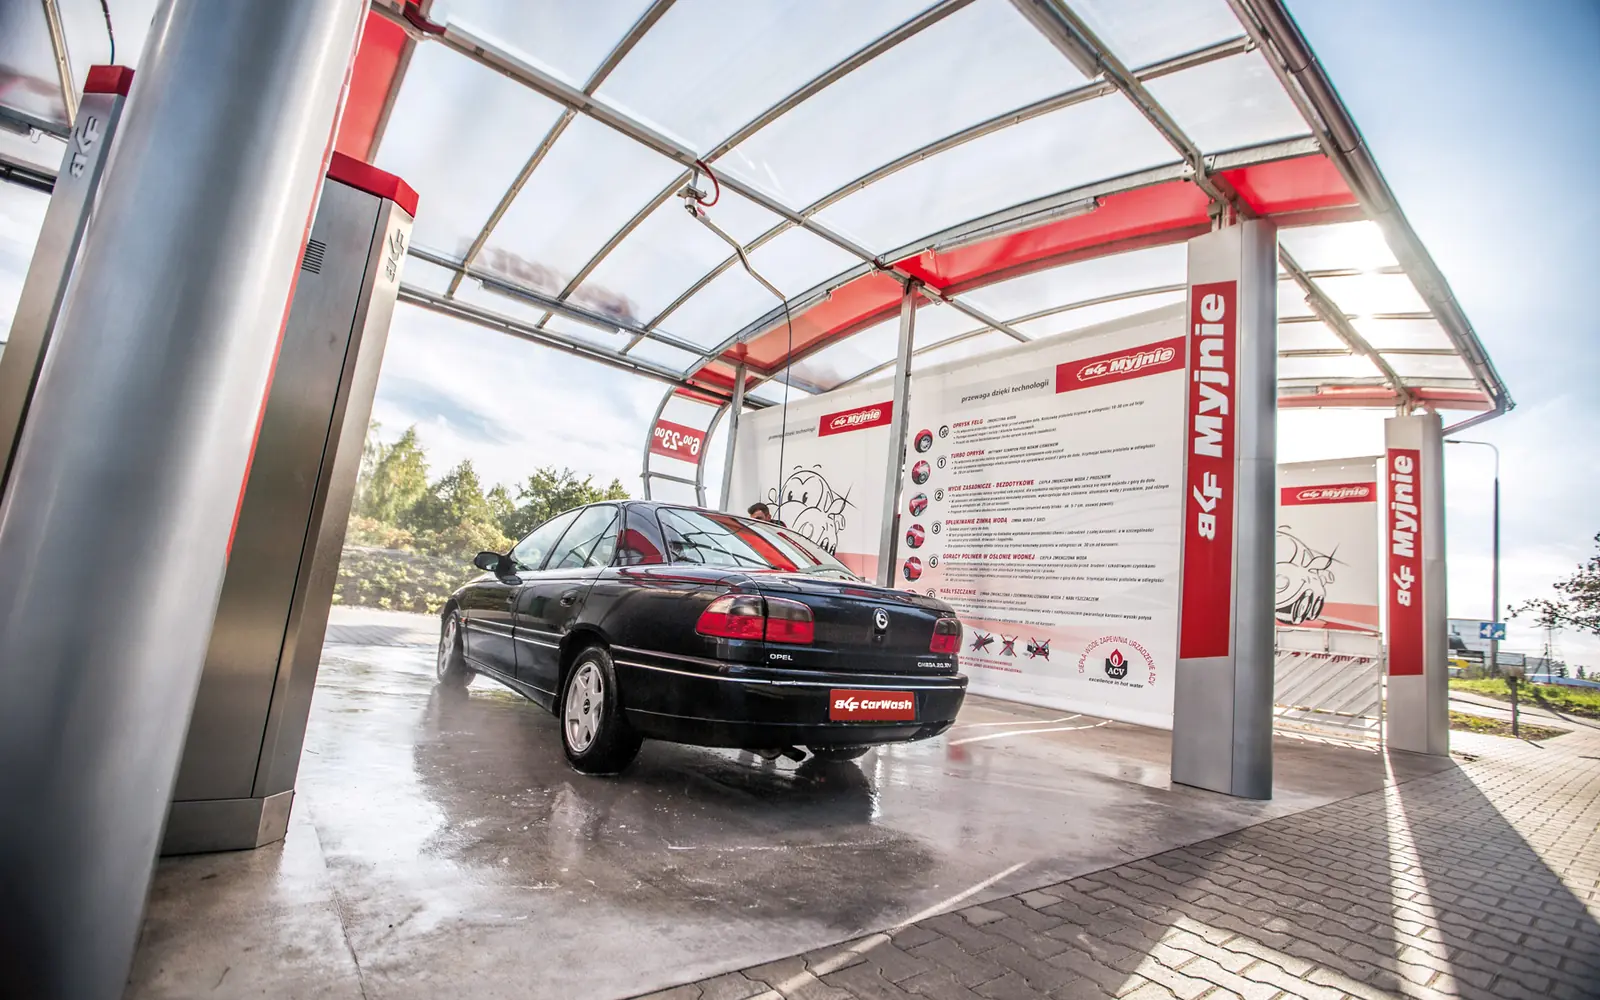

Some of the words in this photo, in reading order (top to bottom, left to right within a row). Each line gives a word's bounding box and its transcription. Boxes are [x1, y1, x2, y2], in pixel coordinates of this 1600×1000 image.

[961, 390, 990, 404] przewaga
[991, 386, 1010, 398] dzięki
[1011, 379, 1050, 394] technologii
[1109, 348, 1174, 372] Myjnie
[1194, 292, 1229, 458] Myjnie
[847, 409, 881, 424] Myjnie
[951, 451, 966, 459] TURBO
[962, 482, 992, 490] ZASADNICZE
[996, 479, 1035, 488] BEZDOTYKOWE
[1320, 486, 1368, 499] Myjnie
[1193, 471, 1219, 541] BKF
[1391, 455, 1418, 558] Myjnie
[1393, 565, 1416, 607] BKF
[1100, 635, 1128, 645] ZAPEWNIA
[770, 653, 793, 662] OPEL
[1108, 667, 1124, 676] ACV
[1088, 676, 1114, 684] excellence
[834, 696, 860, 712] BKF
[860, 700, 912, 710] CarWash
